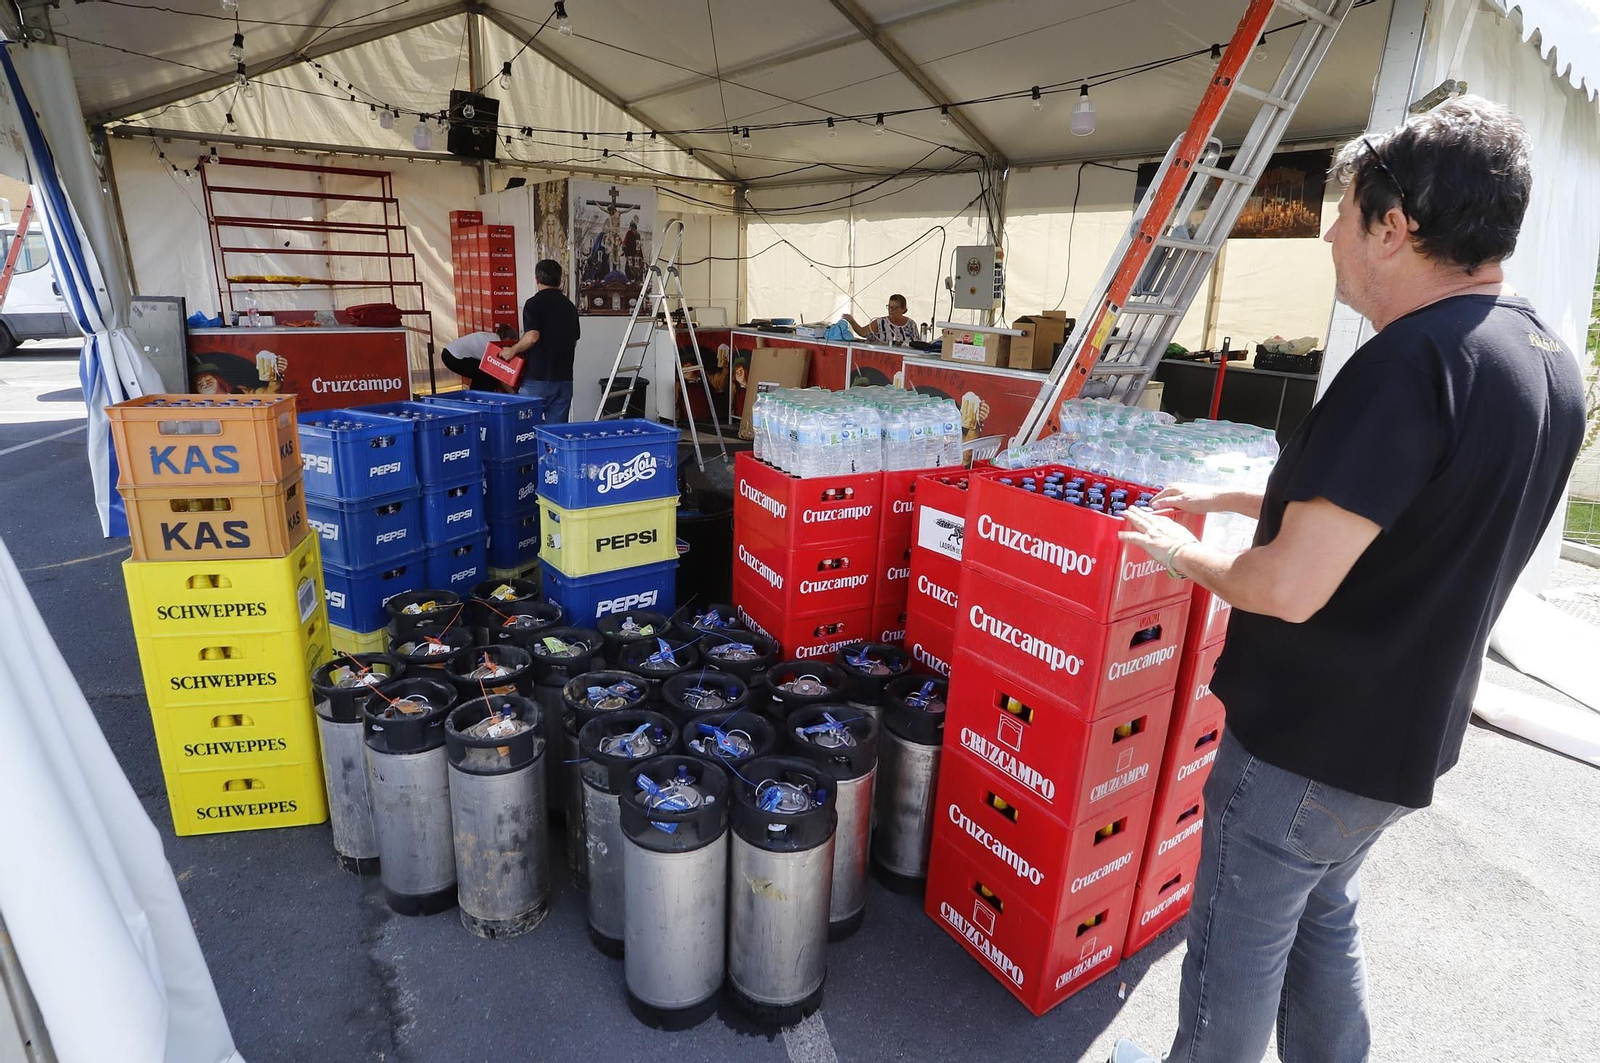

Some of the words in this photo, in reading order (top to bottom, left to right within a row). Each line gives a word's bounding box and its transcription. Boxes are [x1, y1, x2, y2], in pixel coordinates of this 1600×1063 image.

[312, 377, 402, 393] Cruzcampo
[516, 431, 535, 444] PEPSI
[150, 446, 240, 475] KAS
[280, 440, 293, 459] KAS
[443, 448, 470, 462] PEPSI
[300, 452, 332, 474] EPSI
[370, 462, 401, 478] PEPSI
[739, 478, 786, 519] Cruzcampo
[892, 500, 914, 514] Cru
[288, 510, 301, 532] KAS
[446, 509, 472, 524] PEPSI
[802, 506, 871, 524] Cruzcampo
[160, 520, 250, 550] KAS
[308, 518, 338, 540] PSI
[376, 528, 406, 545] PEPSI
[518, 536, 537, 550] PEPSI
[596, 529, 657, 552] PEPSI
[977, 514, 1094, 576] Cruzcampo
[451, 567, 477, 583] PEPSI
[738, 544, 783, 590] Cruzcampo
[887, 567, 910, 580] Cruz
[800, 574, 868, 594] Cruzcampo
[918, 575, 958, 609] Cruzc
[157, 602, 267, 620] SCHWEPPES
[596, 590, 658, 618] PEPSI
[882, 630, 906, 642] Cruz
[969, 604, 1082, 676] Cruzcampo
[913, 643, 952, 679] Cruzc
[1108, 644, 1176, 681] Cruzcampo
[170, 672, 277, 690] SCHWEPPES
[184, 738, 287, 758] SCHWEPPES
[960, 726, 1055, 800] CRUZCAMPO
[1177, 748, 1218, 781] Cruzcam
[1090, 762, 1149, 801] CRUZCAMPO
[196, 800, 297, 820] SCHWEPPES
[948, 803, 1042, 886] Cruzcampo
[1071, 852, 1132, 894] Cruzcampo
[1140, 882, 1191, 926] Cruzcampo
[939, 901, 1024, 986] CRUZCAMPO
[1056, 945, 1113, 988] CRUZCAMPO
